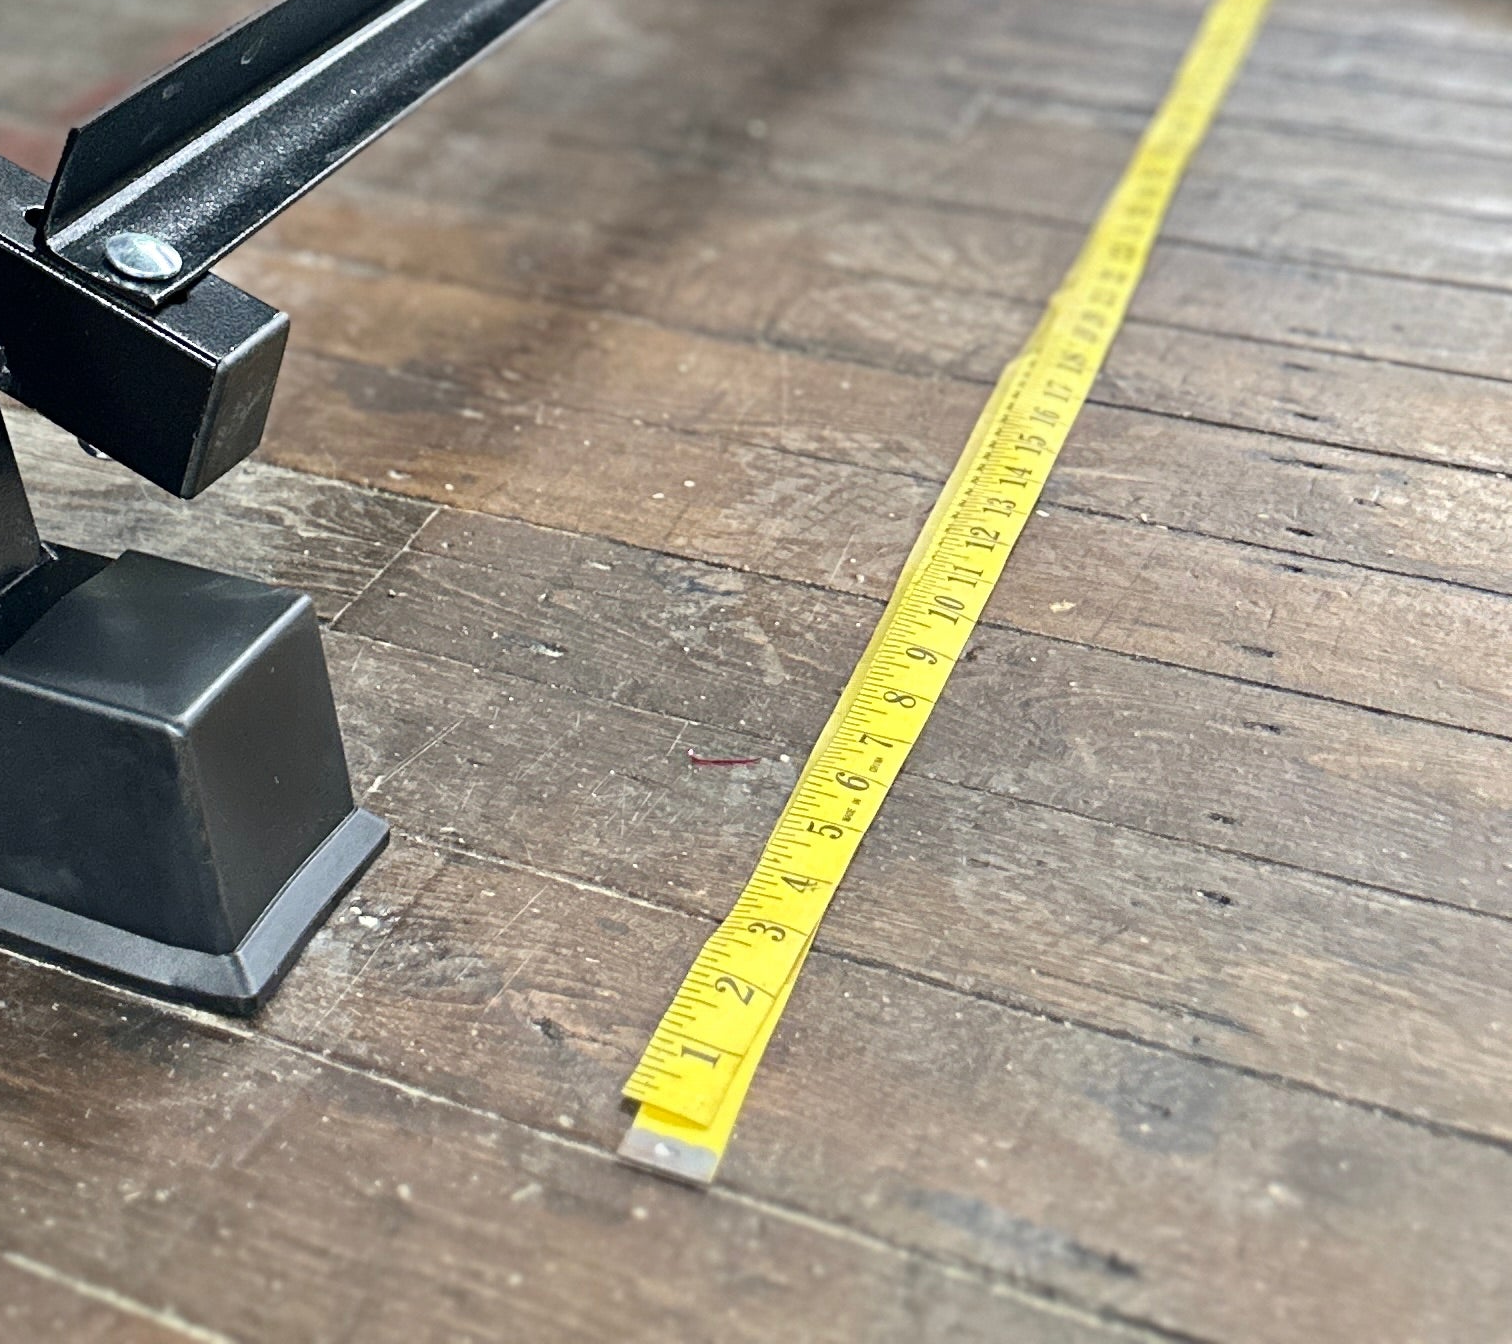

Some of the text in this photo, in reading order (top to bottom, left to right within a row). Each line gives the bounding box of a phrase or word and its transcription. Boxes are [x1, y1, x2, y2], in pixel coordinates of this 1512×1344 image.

[1014, 432, 1048, 456] 15
[999, 464, 1033, 489] 14
[982, 496, 1017, 518] 13
[965, 526, 1001, 553] 12
[947, 565, 984, 588] 11
[928, 595, 965, 626] 10
[905, 647, 938, 665] 9
[883, 690, 916, 709] 8
[858, 733, 894, 748] 7
[835, 771, 870, 791] 6
[807, 820, 844, 840] 5
[780, 875, 818, 894] 4
[748, 921, 787, 943] 3
[715, 976, 756, 1007] 2
[681, 1044, 721, 1069] 1
